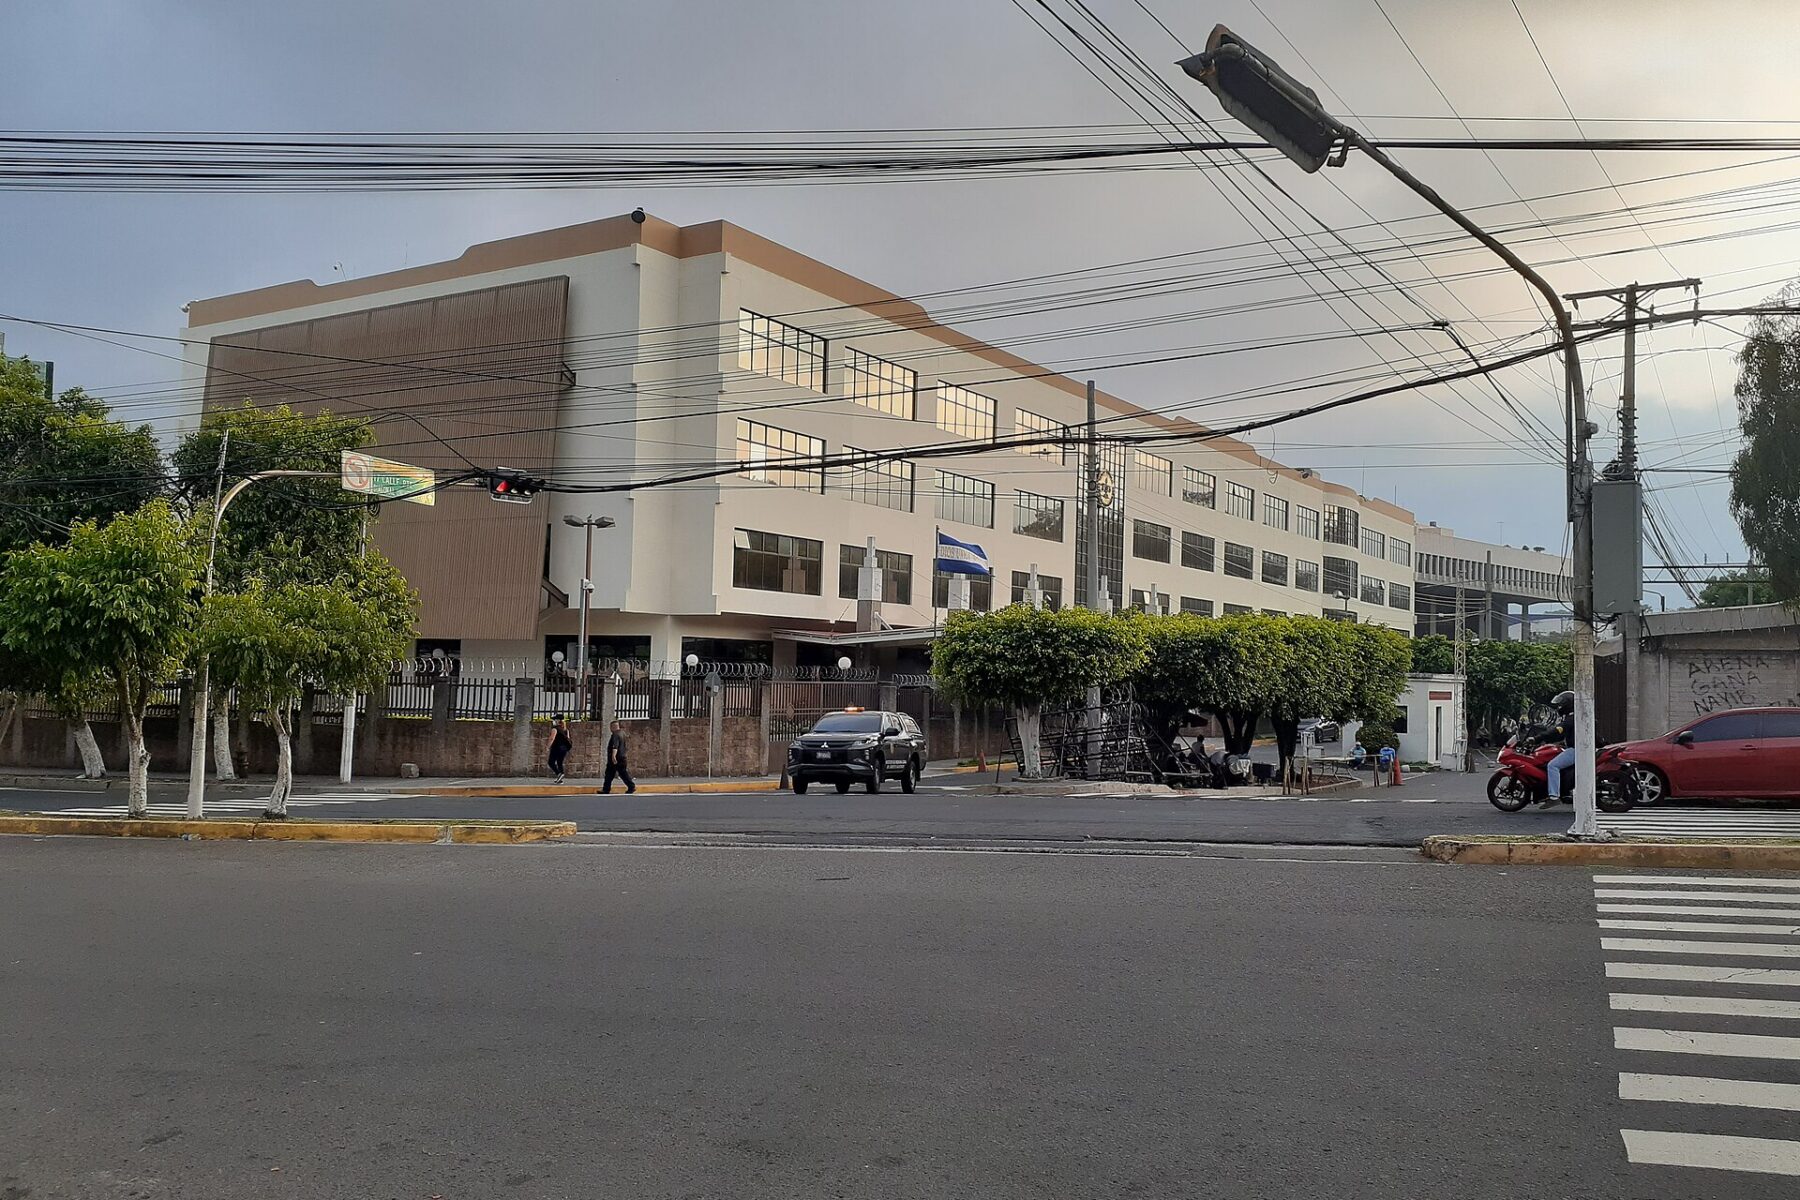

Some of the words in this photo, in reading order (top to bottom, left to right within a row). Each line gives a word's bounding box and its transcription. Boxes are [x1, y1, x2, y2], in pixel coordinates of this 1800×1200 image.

[1688, 656, 1769, 678] ARENA
[1691, 670, 1761, 696] GANA
[1693, 689, 1755, 716] NAYIB
